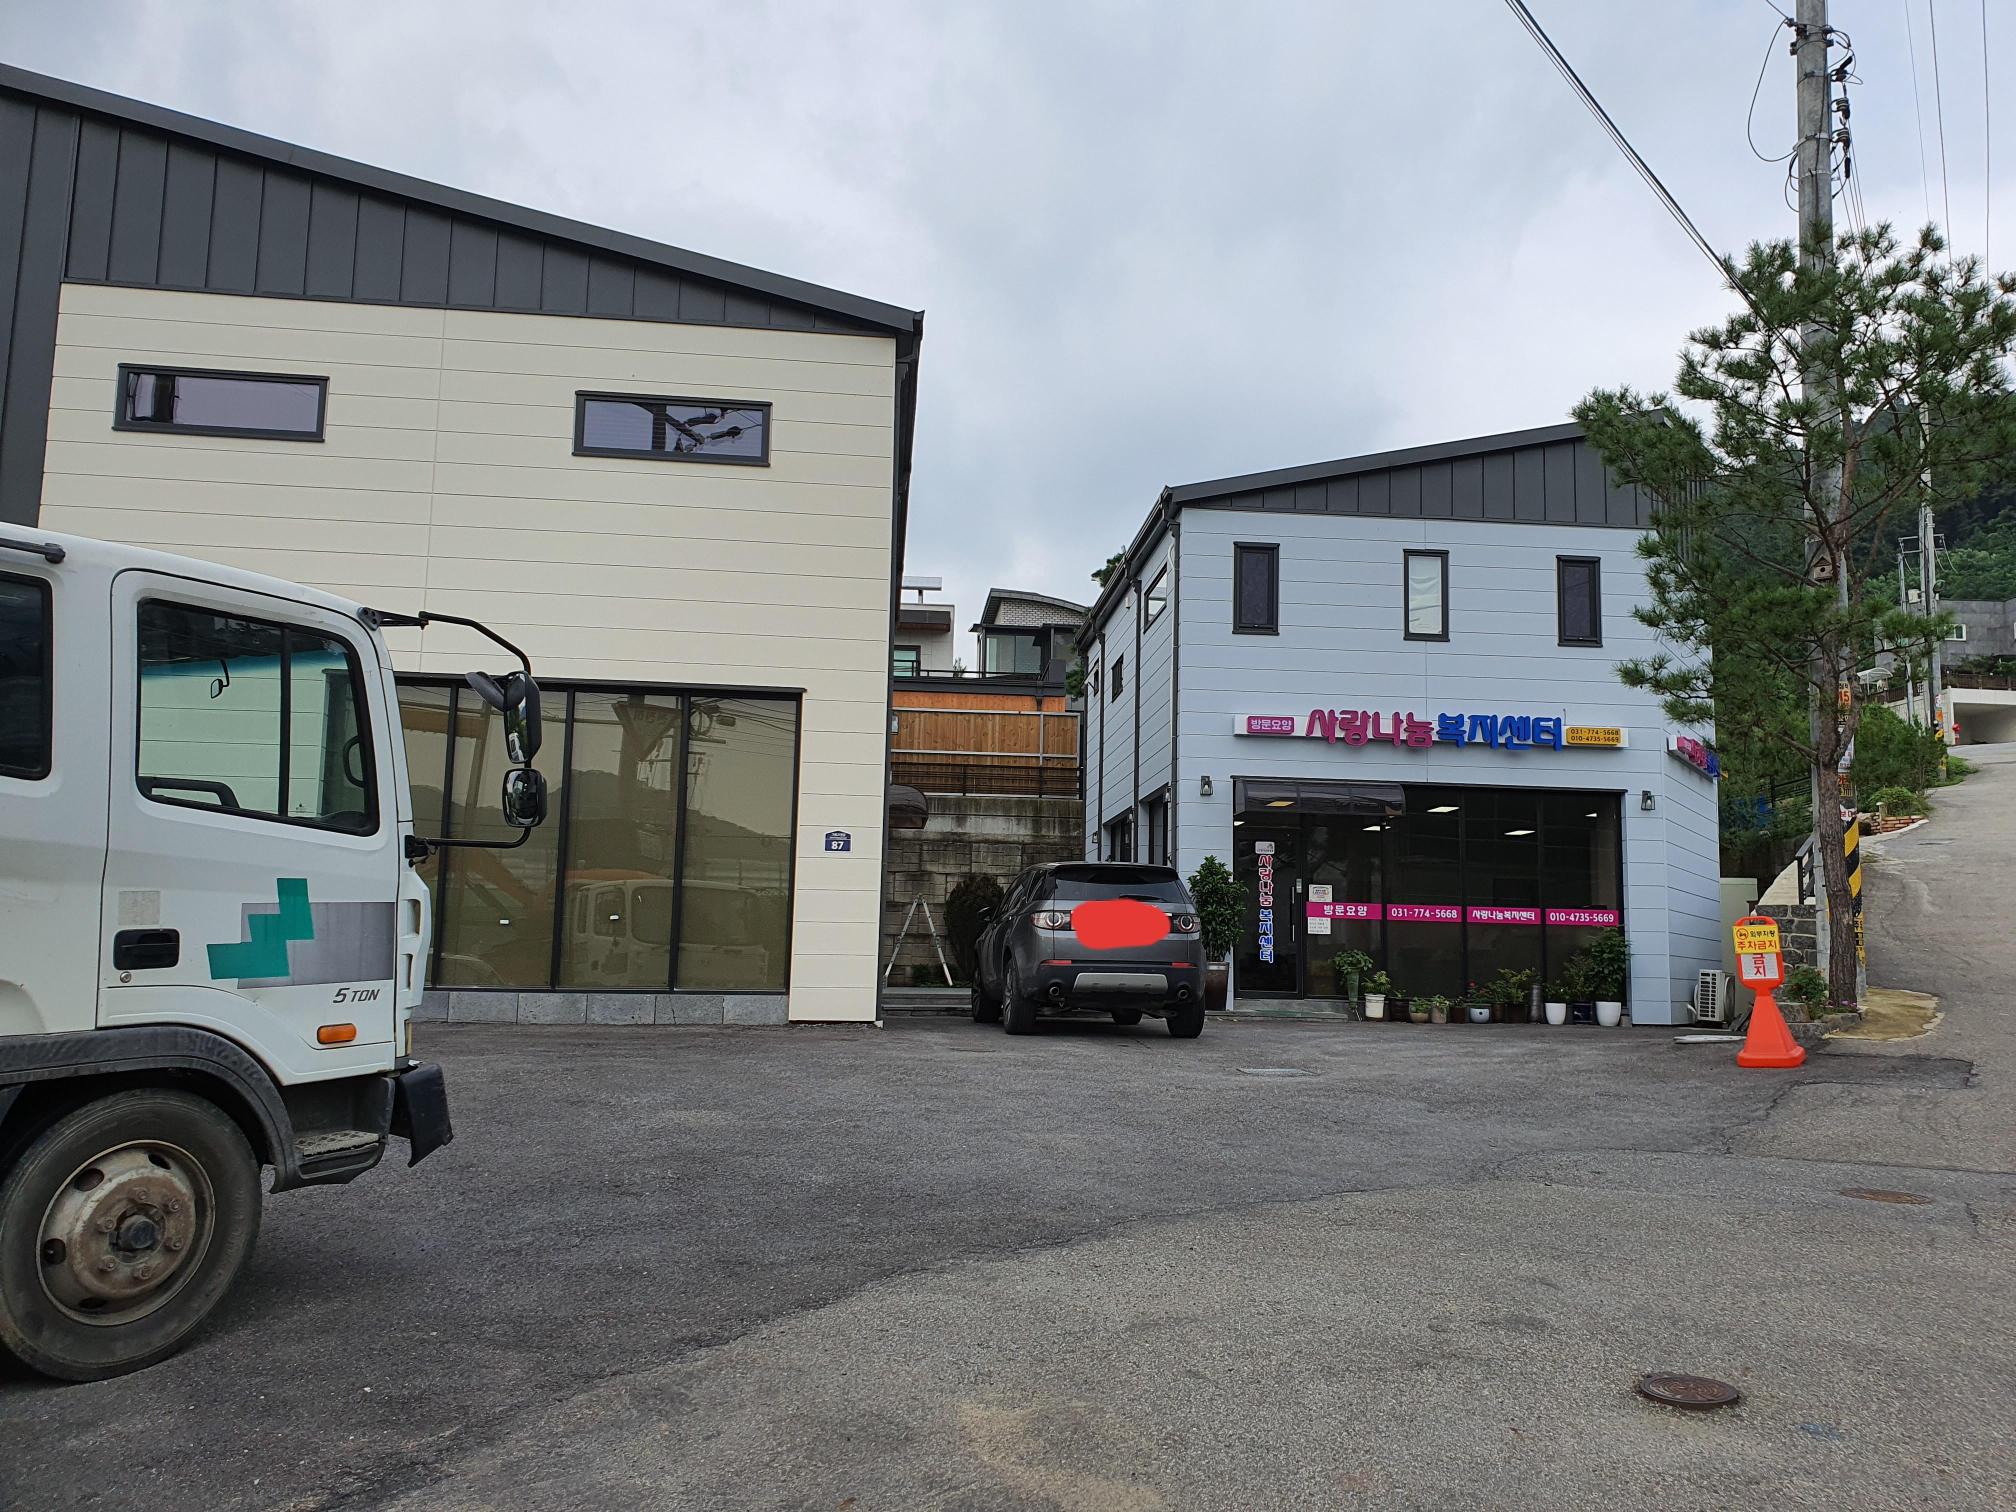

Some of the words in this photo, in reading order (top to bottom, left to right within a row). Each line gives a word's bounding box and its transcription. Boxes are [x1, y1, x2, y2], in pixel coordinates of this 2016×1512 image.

[1251, 719, 1292, 731] 방문요양
[1570, 728, 1619, 736] 031-774-5668
[1570, 735, 1619, 743] 010-4735-5669
[831, 840, 845, 850] 87
[1323, 904, 1368, 917] 방문요양
[1391, 907, 1458, 919] 031-774-5668
[1549, 911, 1614, 923] 010-4735-5669
[1737, 940, 1777, 951] 주차금지
